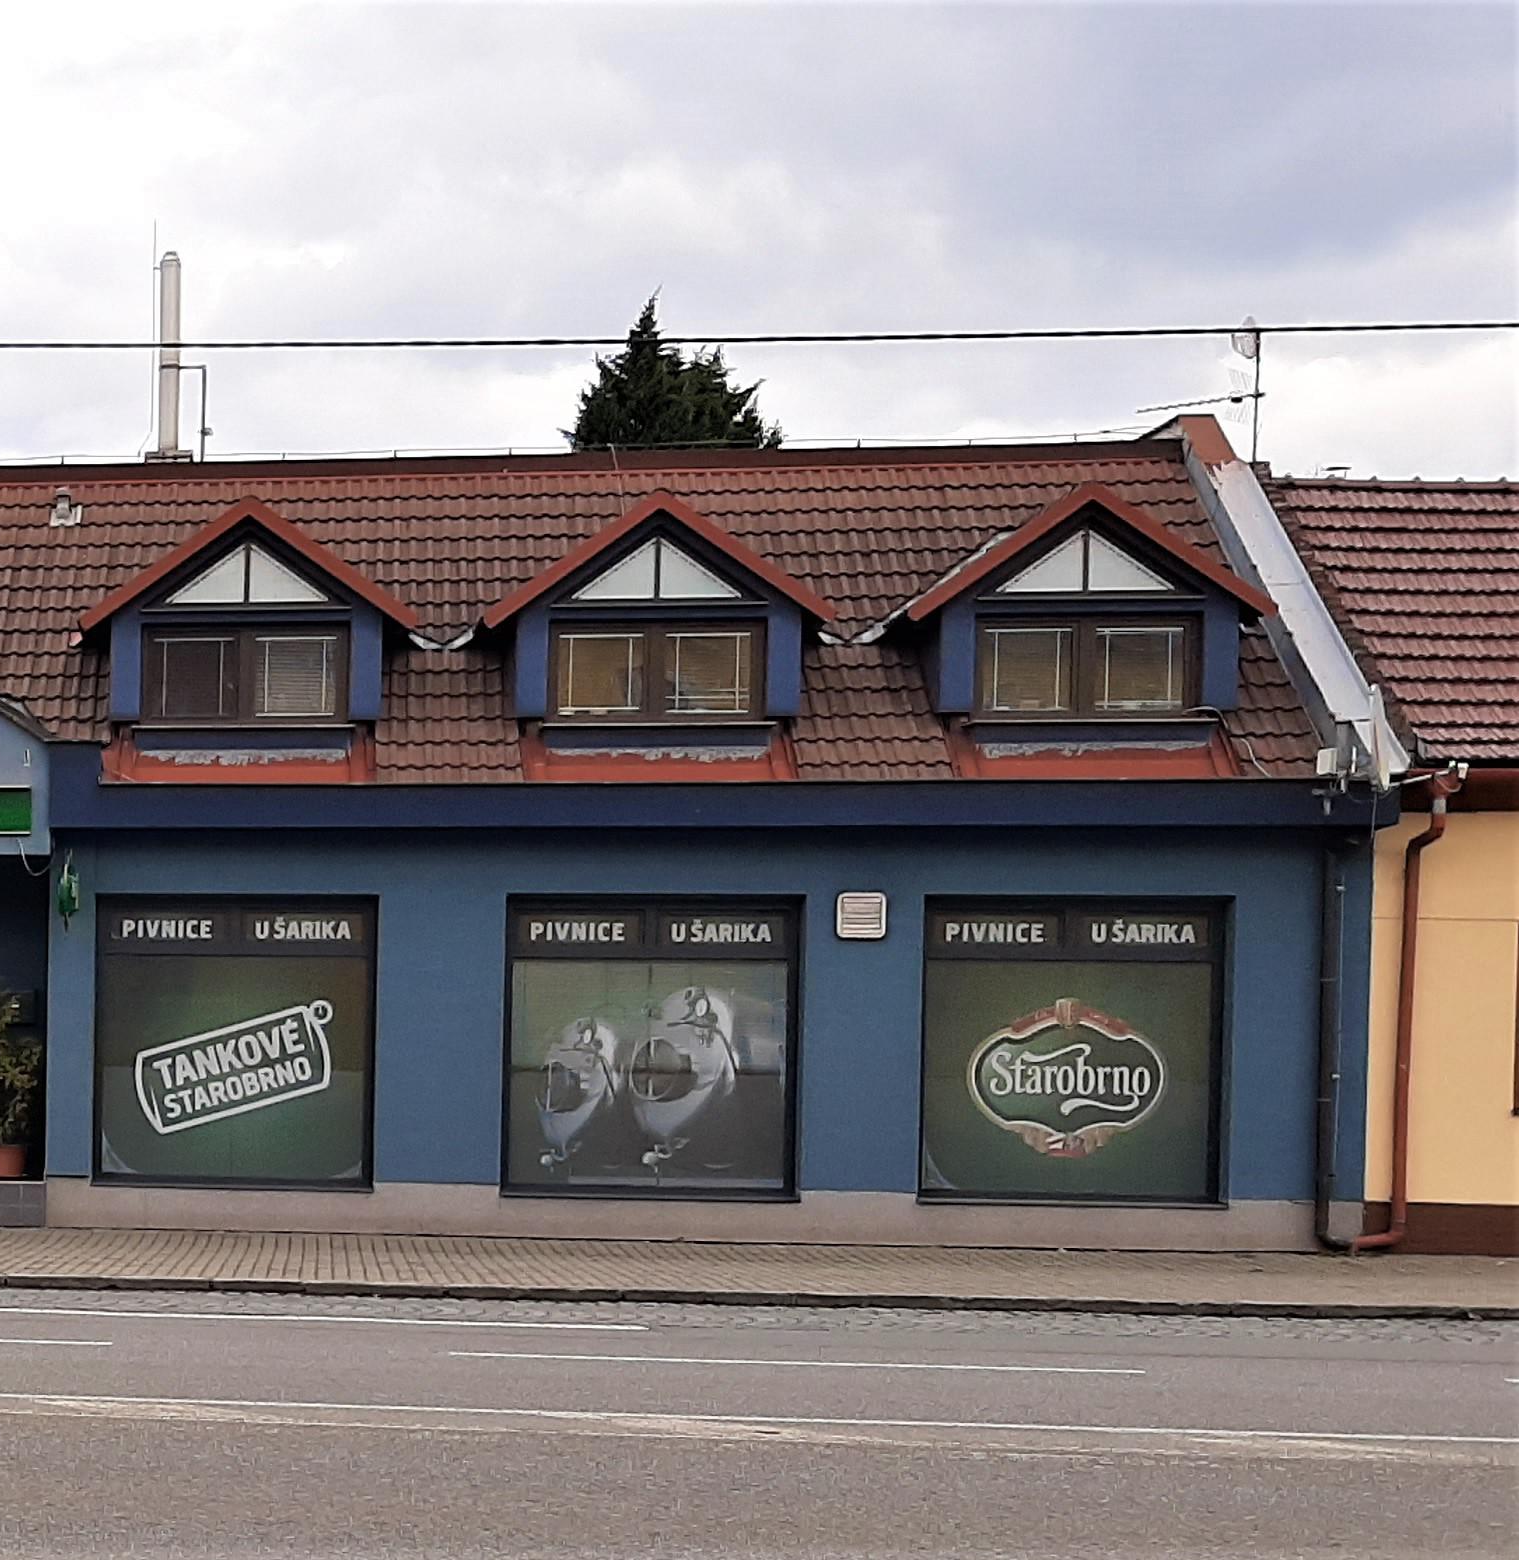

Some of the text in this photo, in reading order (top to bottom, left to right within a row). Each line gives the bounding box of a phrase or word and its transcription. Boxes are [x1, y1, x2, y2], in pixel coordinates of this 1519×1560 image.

[122, 916, 351, 940] PIVNICE U ŠARIKA
[530, 919, 772, 943] PIVNICE U ŠARIKA
[945, 919, 1196, 943] PIVNICE U ŠARIKA
[152, 1018, 305, 1090] TANKOVÉ
[163, 1056, 313, 1119] STAROBRNO
[990, 1043, 1151, 1116] Starobrno
